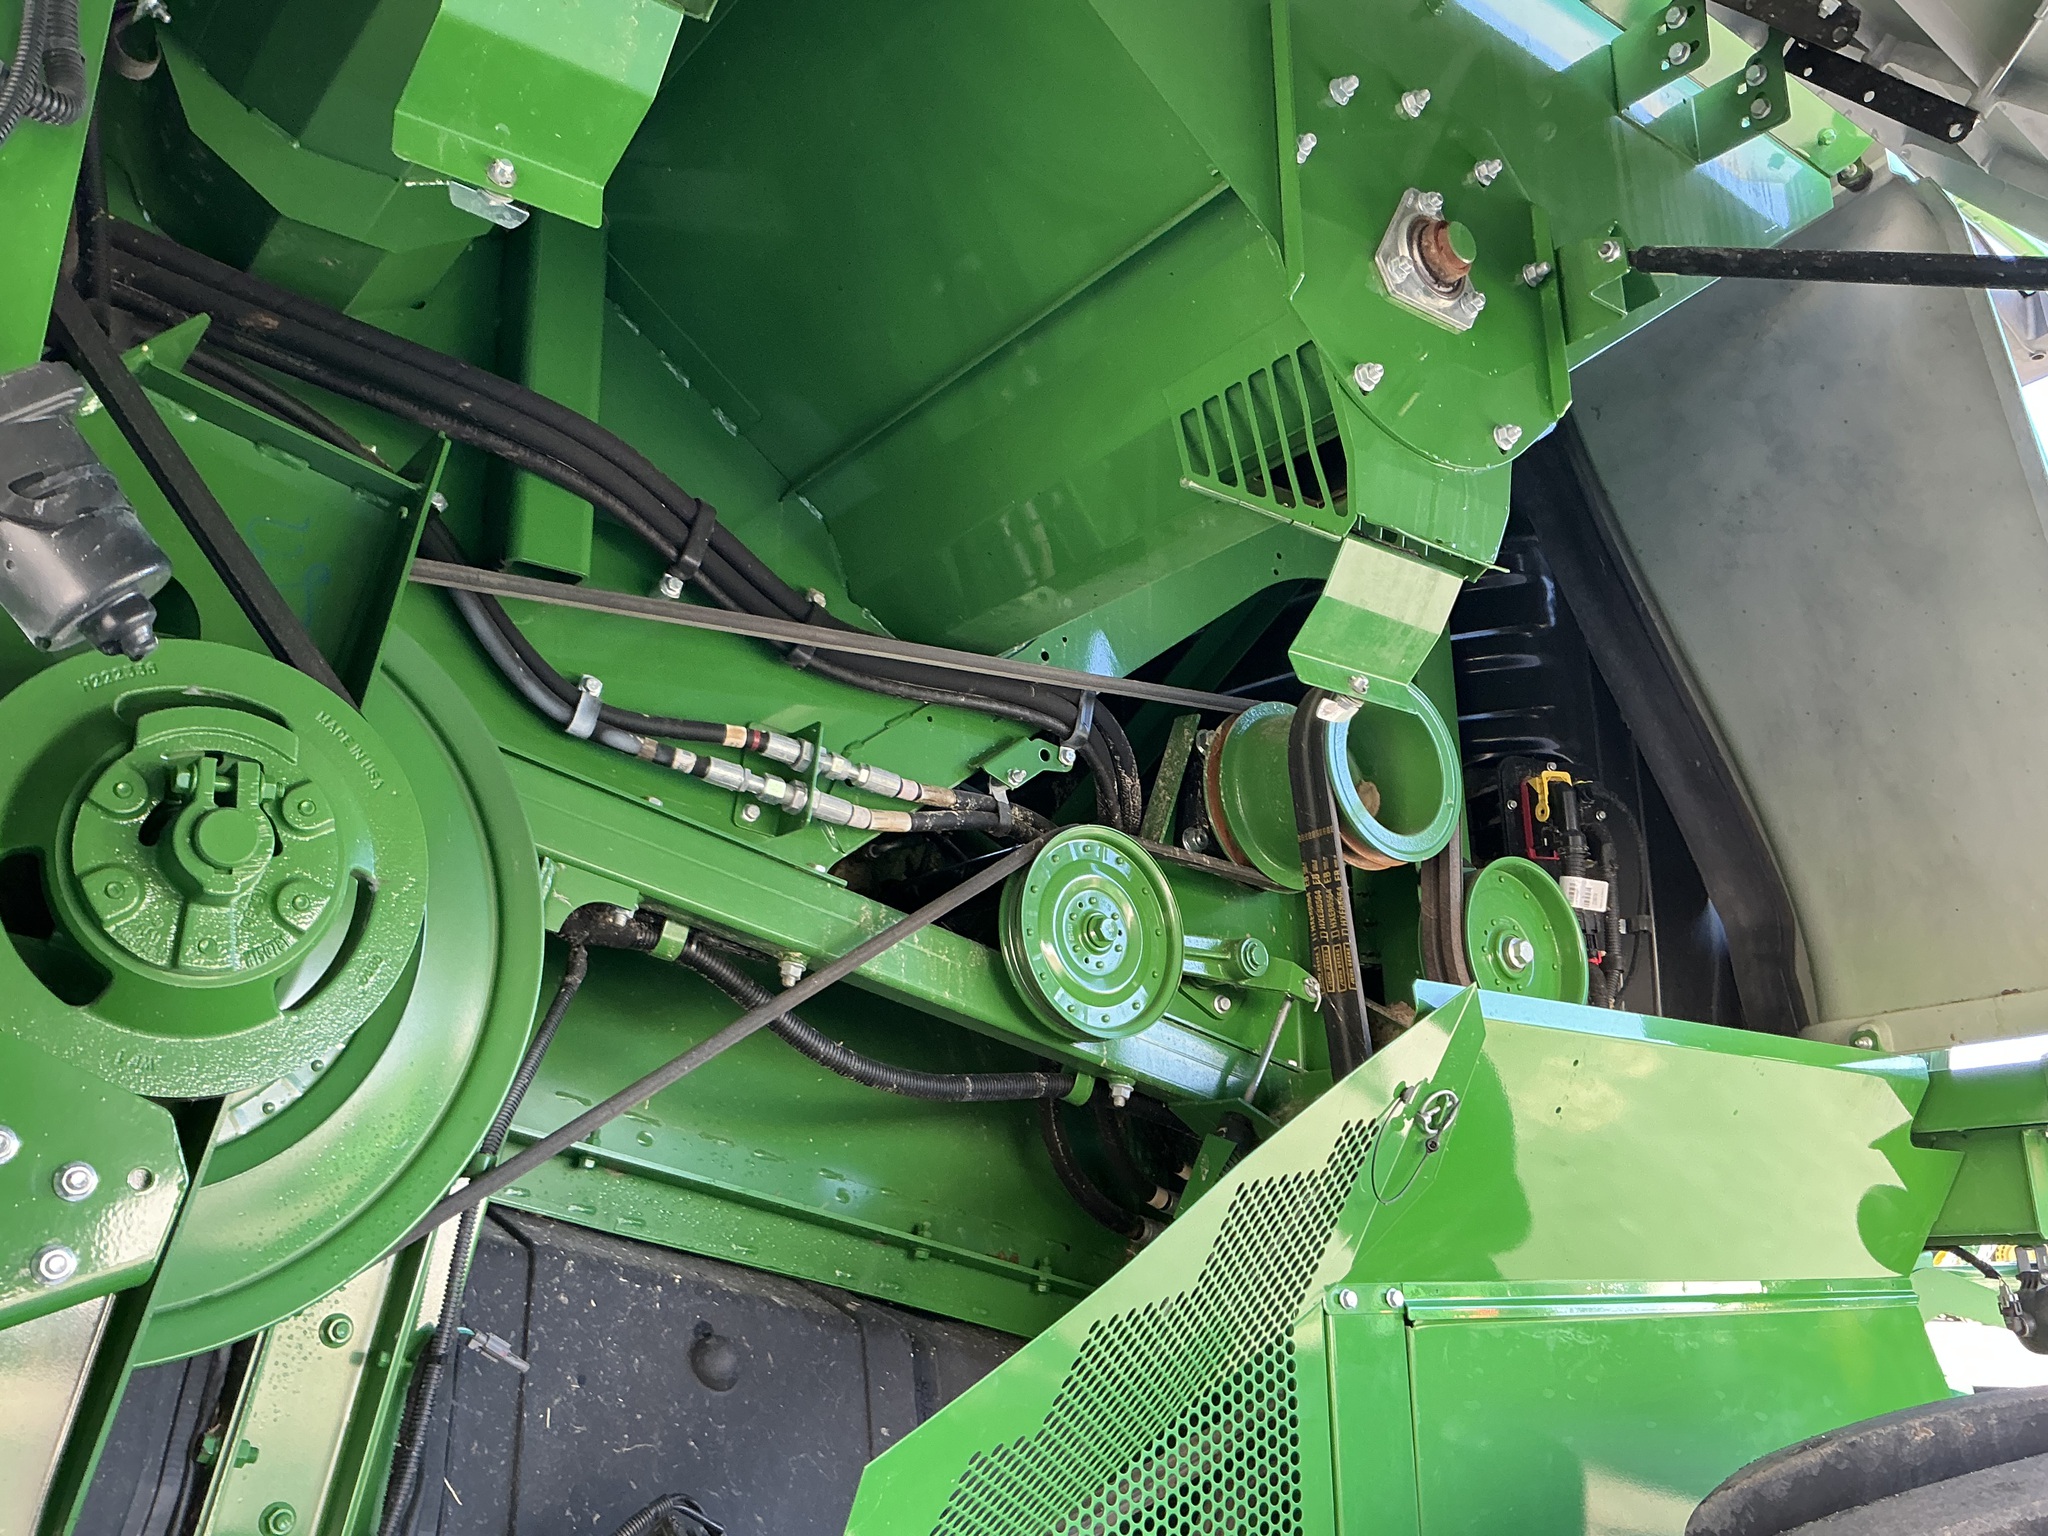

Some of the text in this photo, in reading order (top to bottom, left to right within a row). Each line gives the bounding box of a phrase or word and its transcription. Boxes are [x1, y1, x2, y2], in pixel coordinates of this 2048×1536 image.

[315, 710, 385, 790] MADE IN USA
